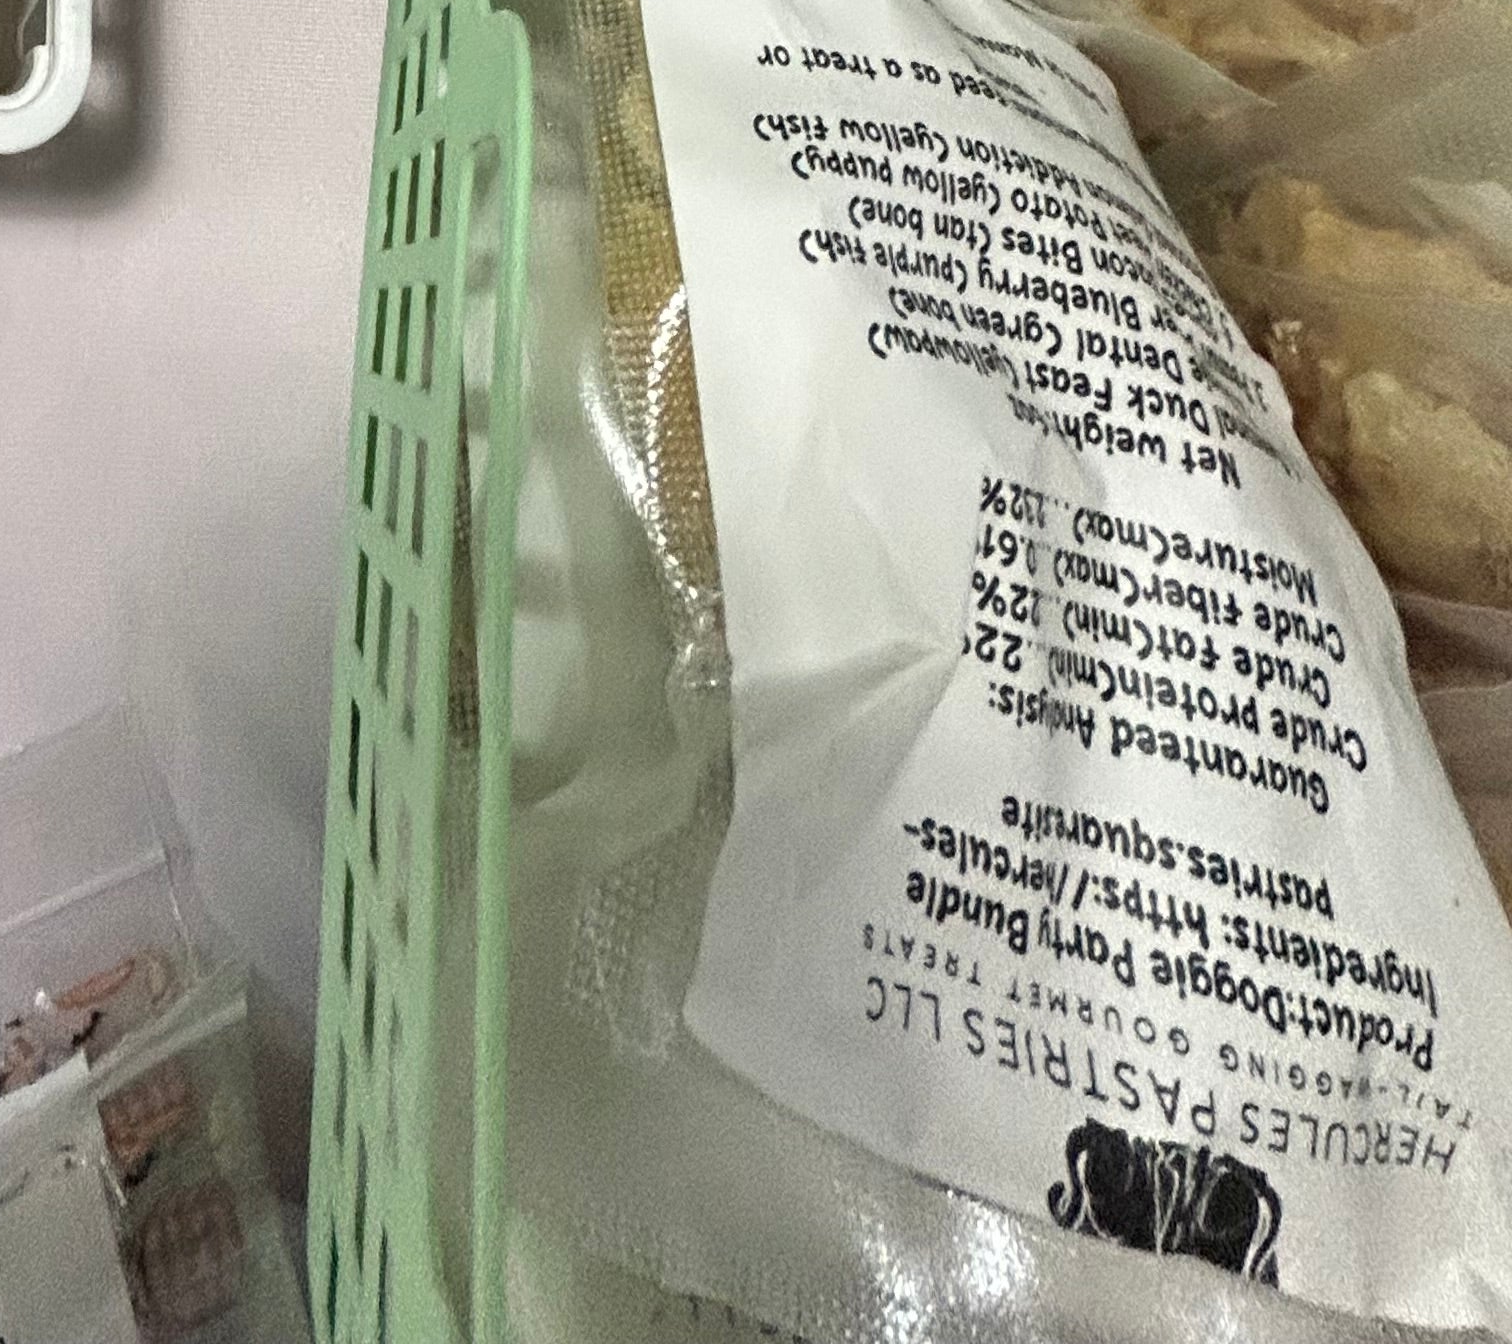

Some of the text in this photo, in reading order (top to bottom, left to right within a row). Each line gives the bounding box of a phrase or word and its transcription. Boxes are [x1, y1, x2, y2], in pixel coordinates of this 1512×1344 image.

[755, 44, 790, 67] or
[800, 47, 876, 82] treat
[883, 58, 903, 79] a
[911, 62, 941, 87] as
[752, 113, 829, 142] fish)
[839, 119, 949, 163] (yellow
[790, 145, 893, 187] puppy)
[902, 164, 1001, 216] (yellow
[955, 136, 1082, 195] Addiction
[848, 196, 924, 241] bone)
[933, 212, 991, 255] (tan
[1011, 188, 1109, 243] Potato
[798, 229, 866, 266] fish)
[872, 242, 968, 294] (purple
[1000, 227, 1084, 276] Bites
[888, 287, 961, 332] bone)
[978, 257, 1142, 332] Blueberry
[961, 302, 1062, 358] (green
[1077, 328, 1184, 385] Dental
[1023, 360, 1112, 413] Feast
[1126, 384, 1210, 437] Duck
[1181, 442, 1241, 490] Net
[1253, 602, 1346, 664] Crude
[1232, 646, 1331, 710] Crude
[1110, 716, 1330, 816] Guaranteed
[1269, 708, 1368, 773] Crude
[906, 871, 1030, 955] Bundle
[862, 923, 981, 987] TREATS
[1037, 906, 1137, 989] Party
[1220, 913, 1438, 1020] Ingredients:
[1007, 978, 1190, 1056] GOURMET
[865, 976, 1456, 1175] HERCULES PASTRIES LLC
